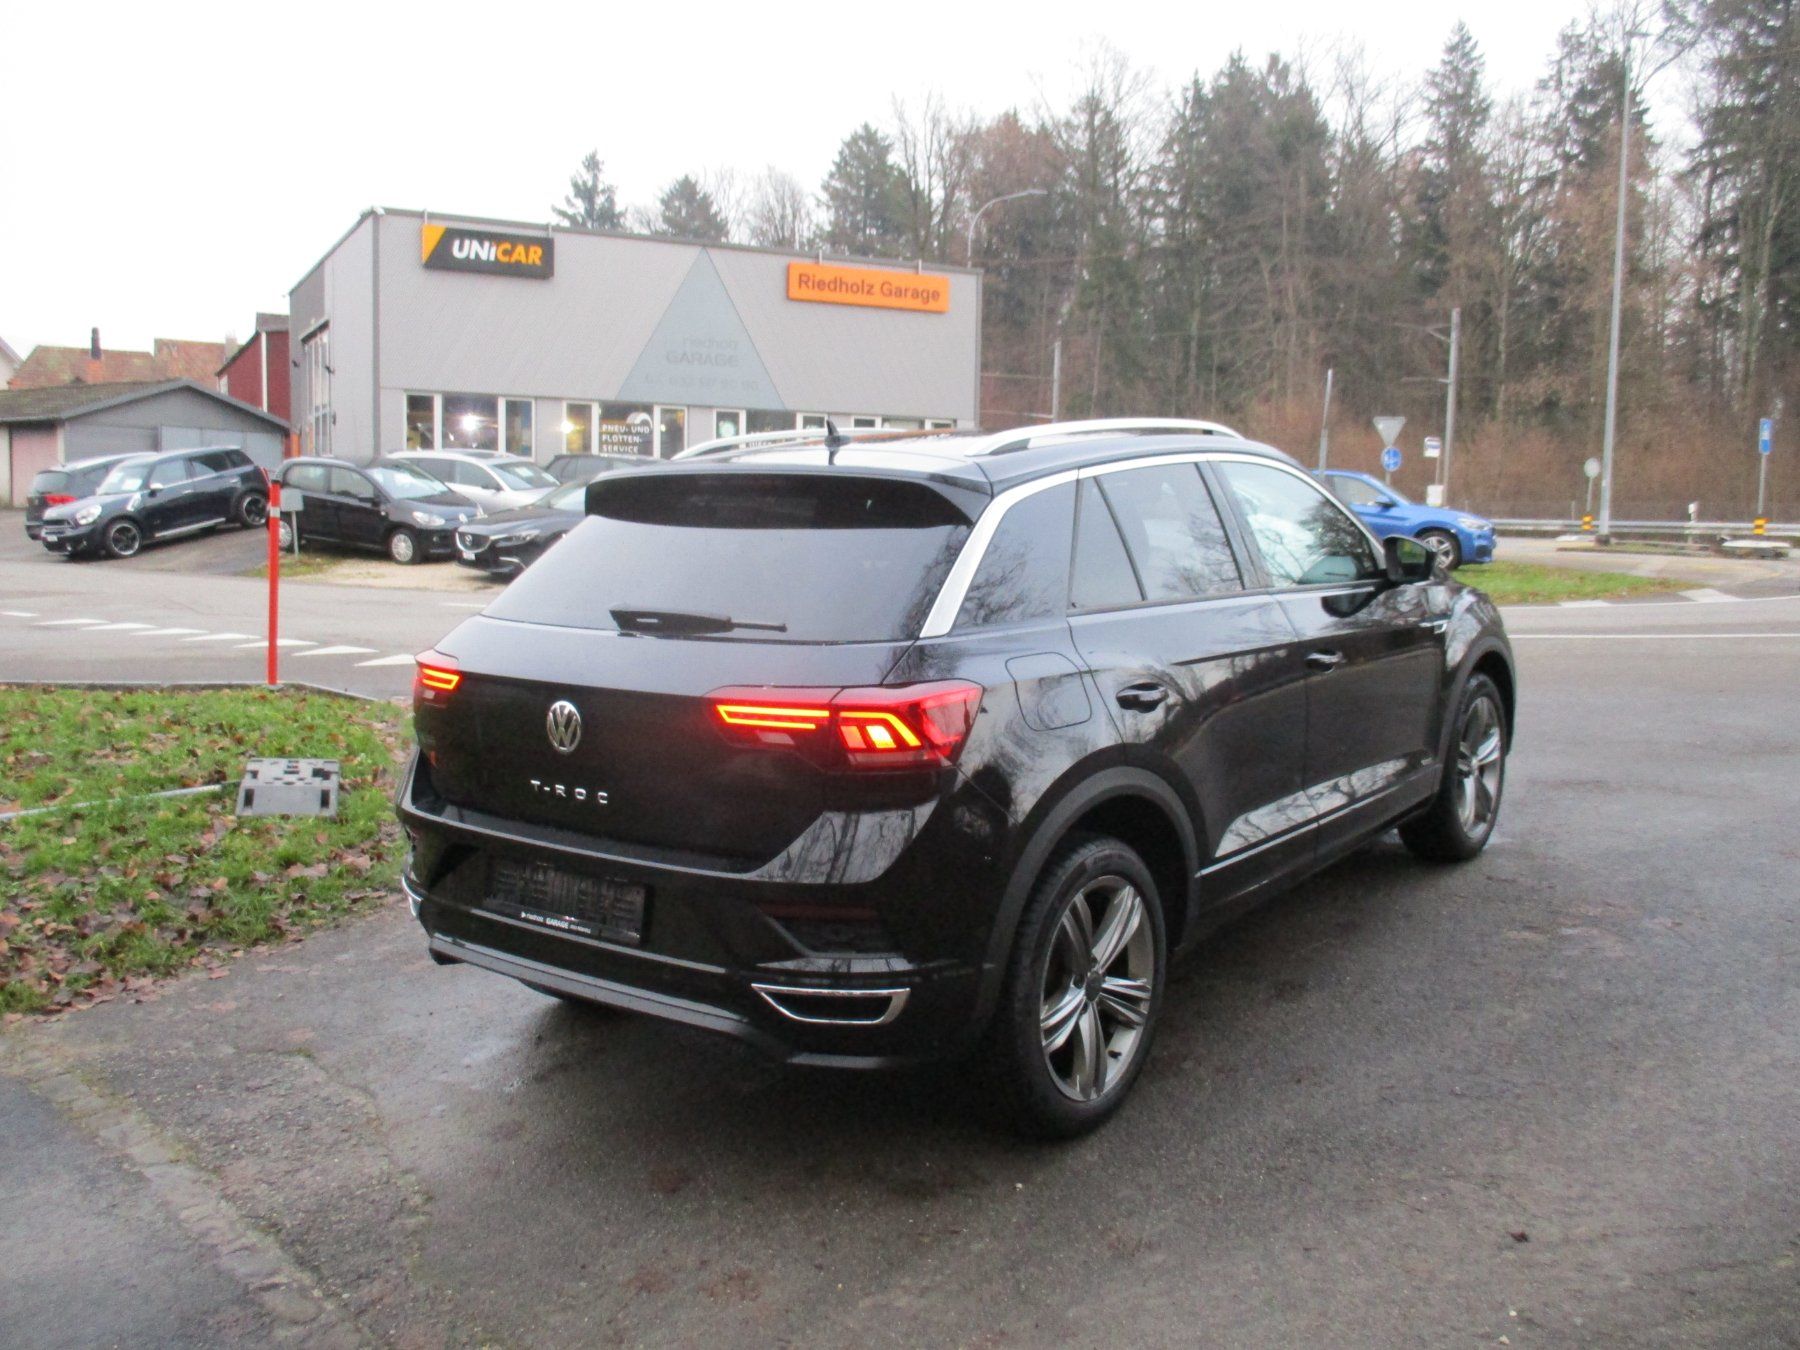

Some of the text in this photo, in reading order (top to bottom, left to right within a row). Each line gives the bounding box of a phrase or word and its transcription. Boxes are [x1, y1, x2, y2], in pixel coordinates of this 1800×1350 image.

[798, 273, 941, 305] Riedholz Garage
[665, 349, 739, 368] GARAGE
[631, 425, 650, 434] UND
[602, 444, 639, 454] SERVICE
[530, 779, 609, 804] T-ROC
